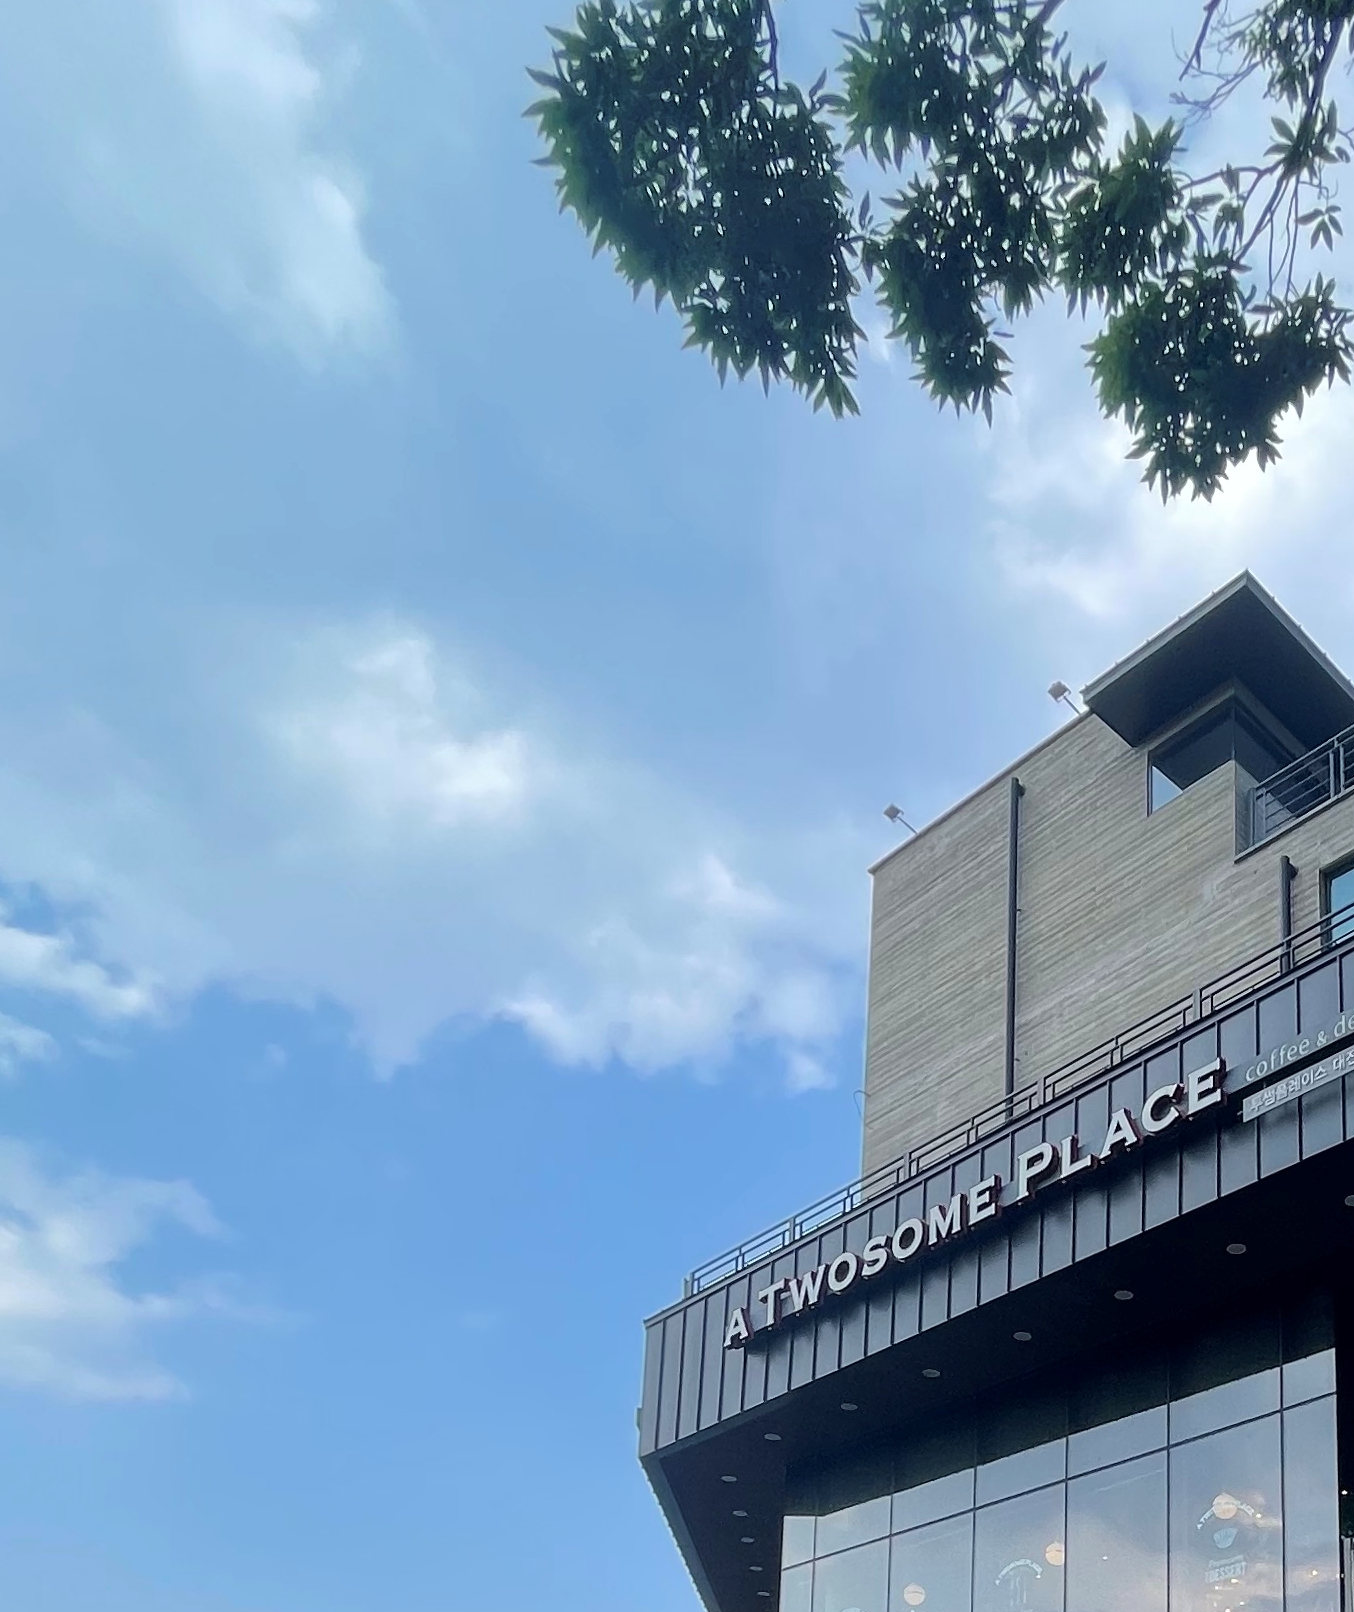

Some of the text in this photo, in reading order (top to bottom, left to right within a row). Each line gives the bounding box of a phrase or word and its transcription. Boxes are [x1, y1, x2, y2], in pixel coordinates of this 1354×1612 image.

[1245, 1038, 1310, 1082] coffee
[1316, 1030, 1328, 1047] &
[1249, 1066, 1328, 1112] 투썸플레이스
[723, 1057, 1224, 1348] A TWOSOME PLACE
